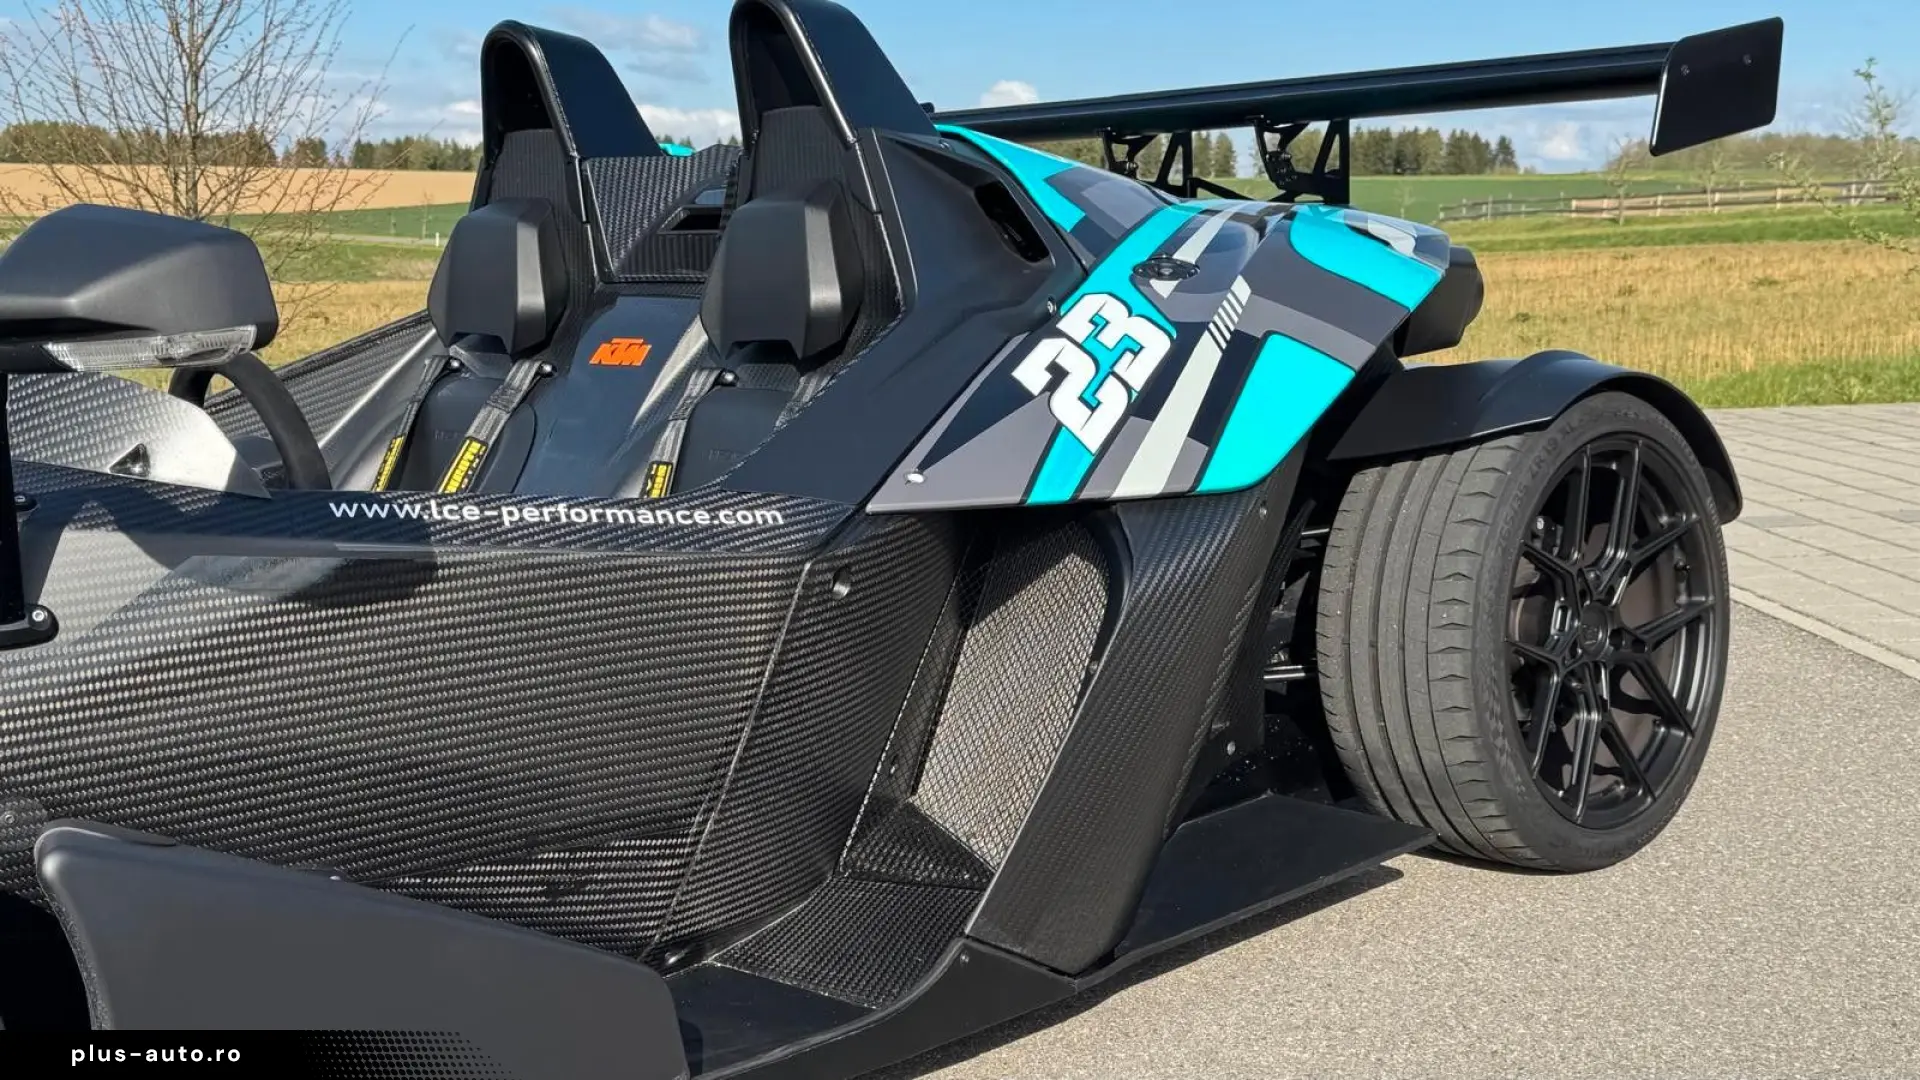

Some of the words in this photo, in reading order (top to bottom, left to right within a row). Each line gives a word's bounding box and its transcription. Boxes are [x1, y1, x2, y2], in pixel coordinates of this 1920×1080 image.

[588, 337, 653, 367] KTM
[1010, 292, 1172, 456] 23
[328, 499, 785, 528] www.lce-performance.com
